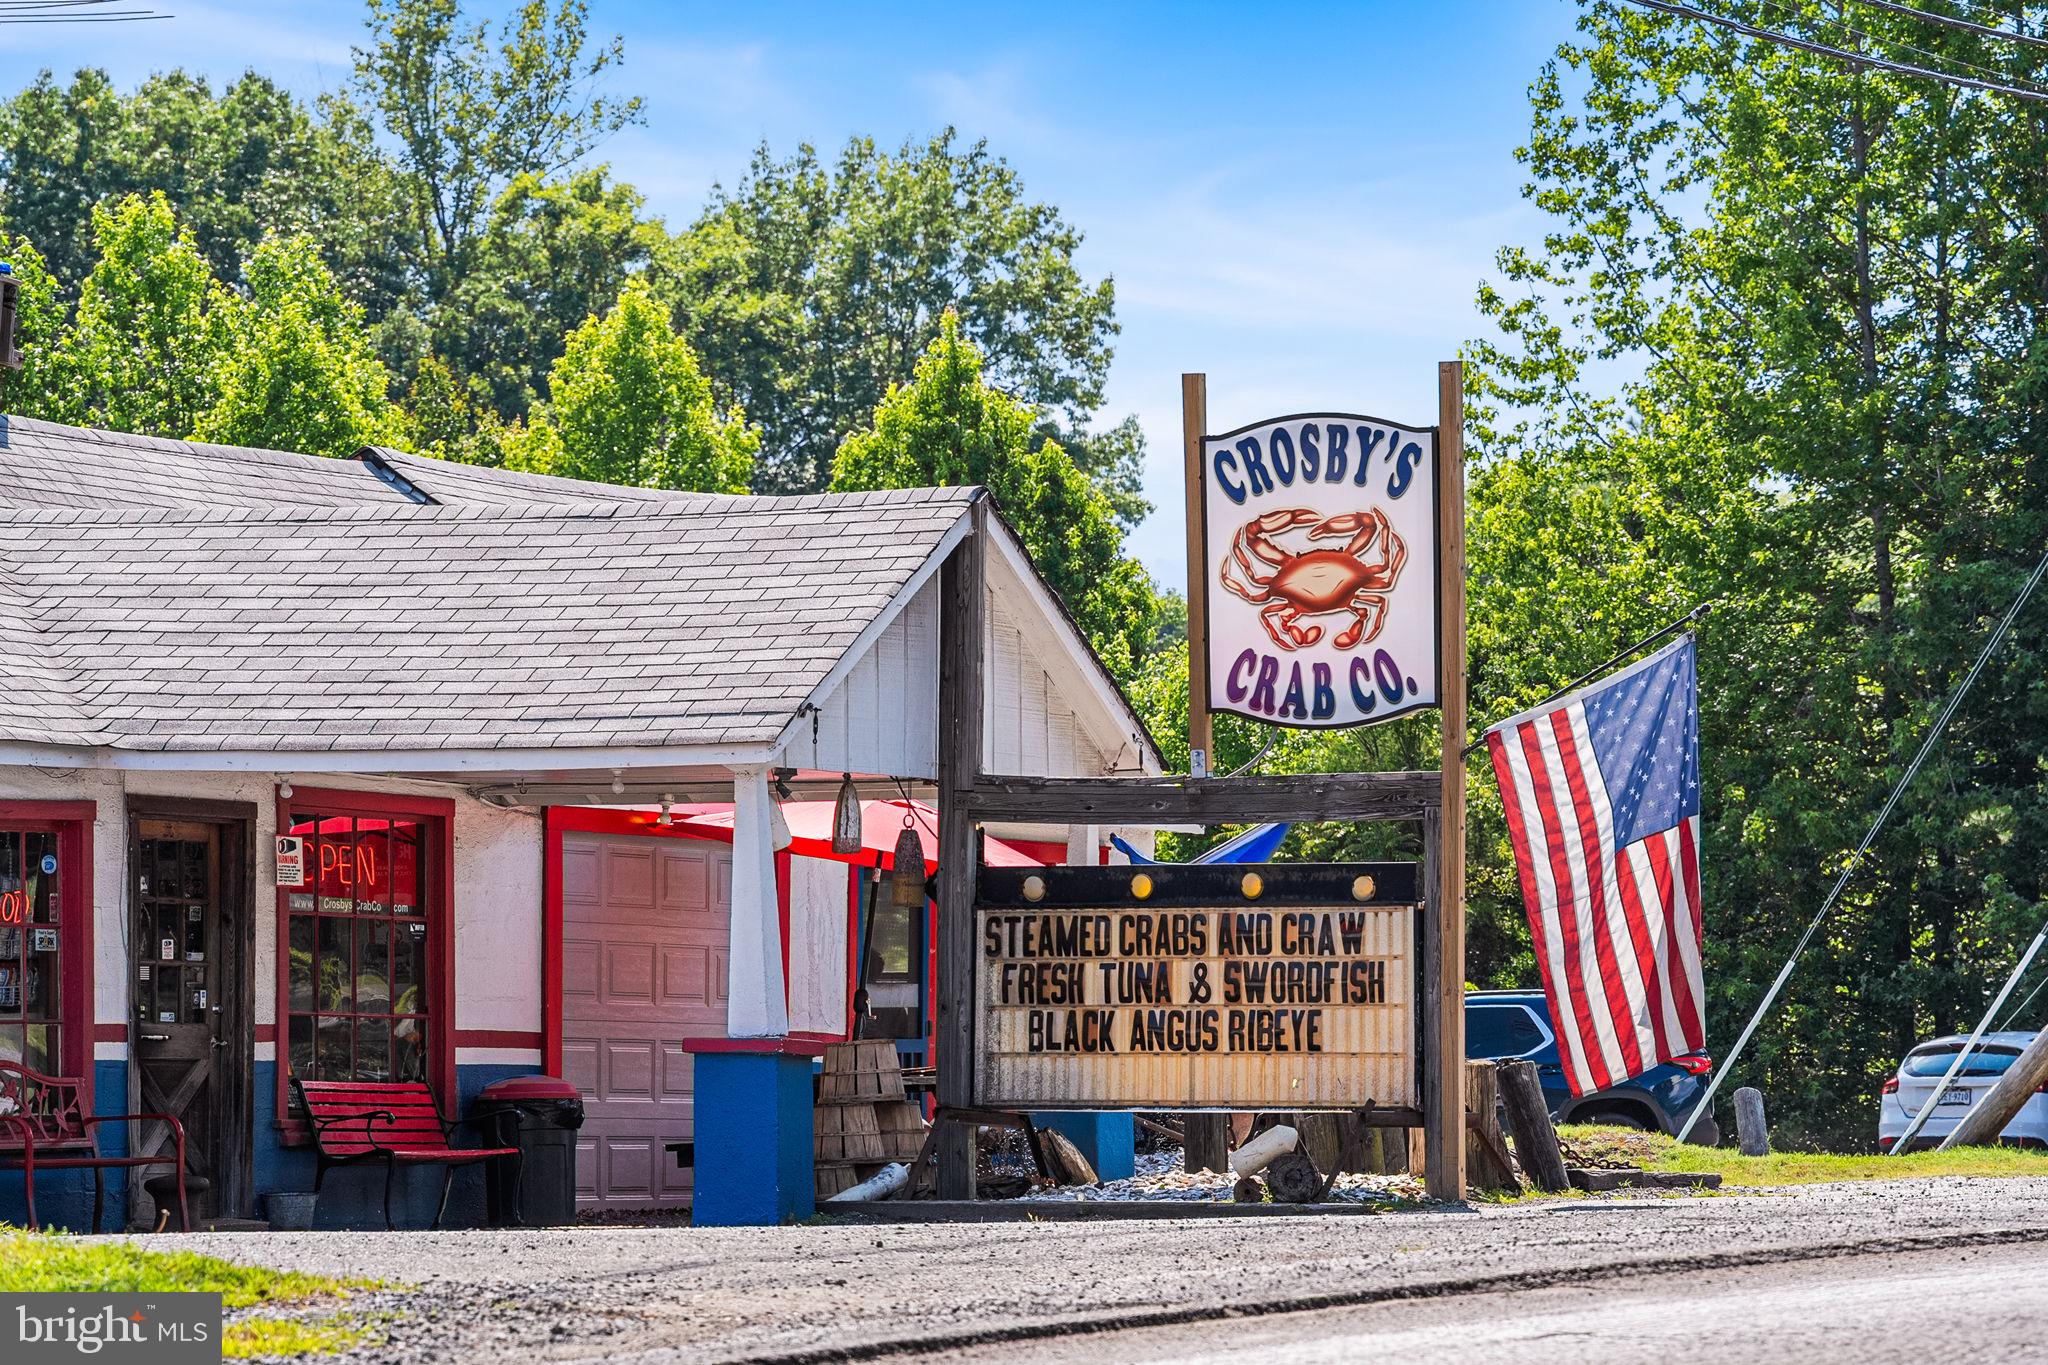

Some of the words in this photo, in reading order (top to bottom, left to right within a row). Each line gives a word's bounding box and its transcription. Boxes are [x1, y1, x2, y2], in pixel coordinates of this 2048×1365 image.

[1213, 422, 1422, 505] CROSBY'S
[1226, 648, 1336, 720] CRAB
[1349, 648, 1419, 714] CO.
[303, 841, 375, 886] OPEN
[985, 912, 1111, 958] STEAMED
[1119, 912, 1207, 957] CRABS
[1218, 912, 1273, 956] AND
[1280, 912, 1366, 957] CRAW
[1001, 961, 1085, 1005] FRESH
[1099, 961, 1173, 1004] TUNA
[1189, 961, 1211, 1004] &
[1224, 960, 1385, 1004] SWORDFISH
[1028, 1009, 1116, 1053] BLACK
[1130, 1009, 1219, 1052] ANGUS
[1228, 1008, 1322, 1052] RIBEYE
